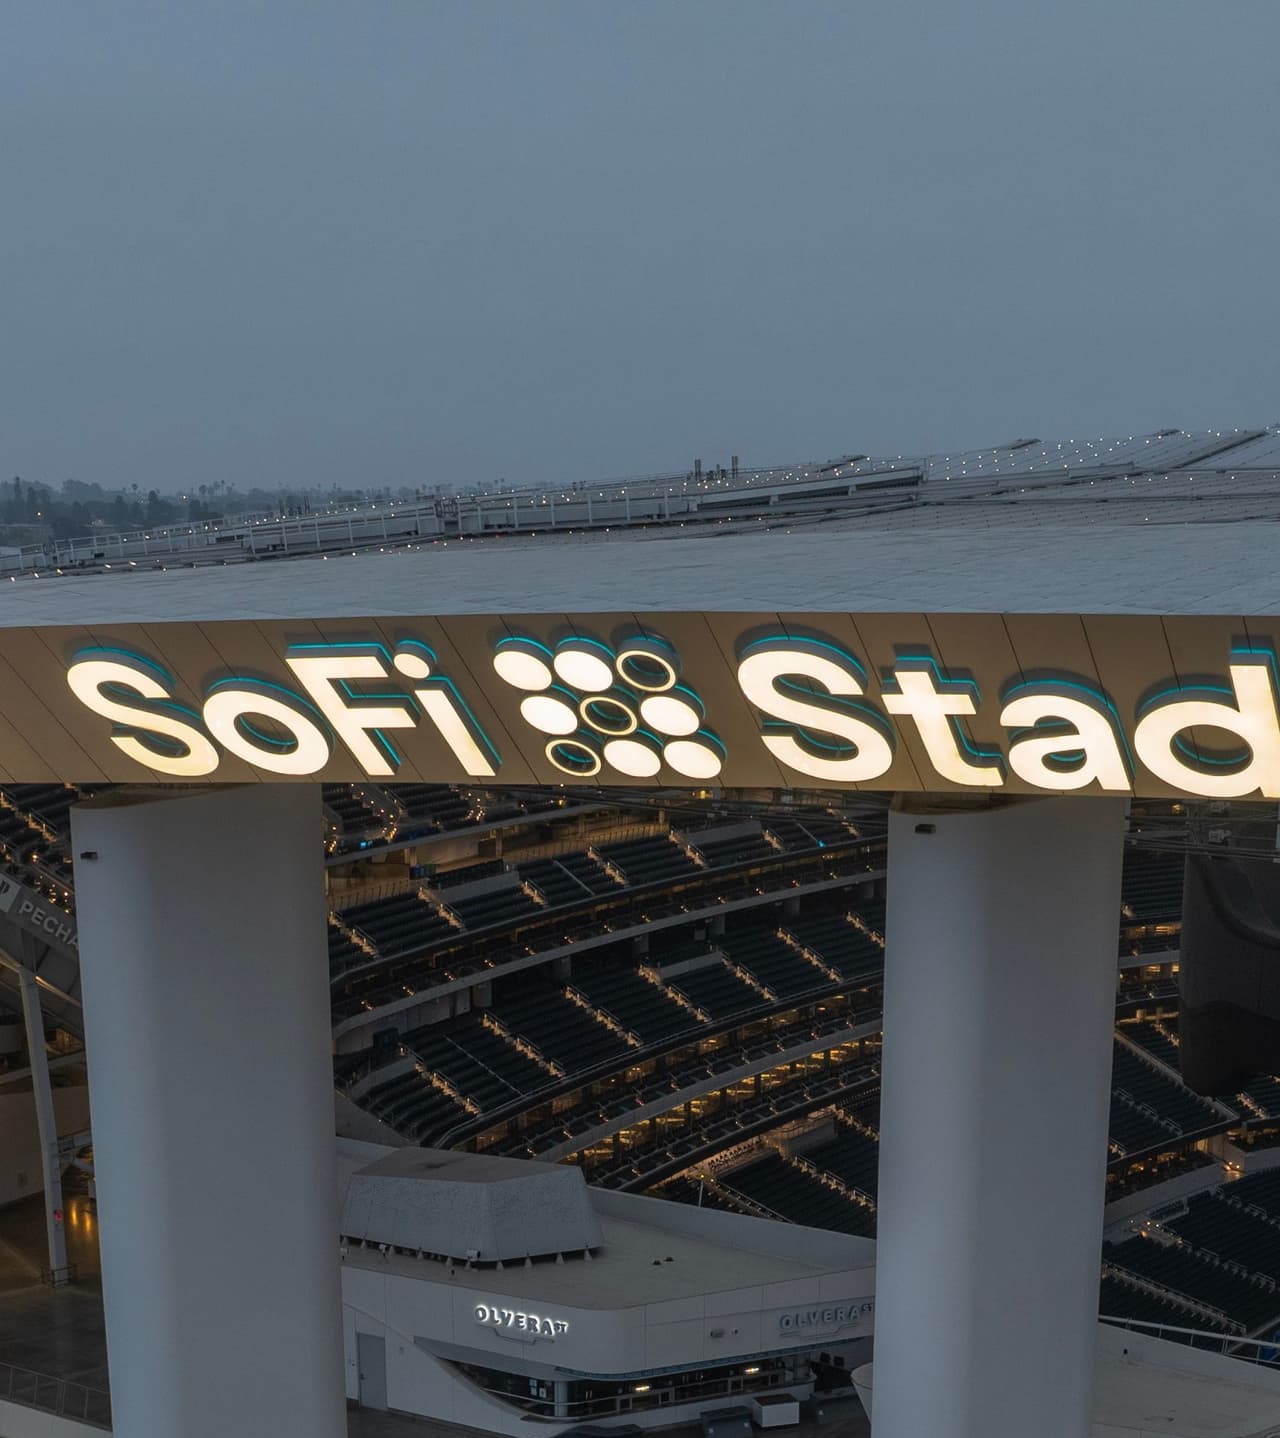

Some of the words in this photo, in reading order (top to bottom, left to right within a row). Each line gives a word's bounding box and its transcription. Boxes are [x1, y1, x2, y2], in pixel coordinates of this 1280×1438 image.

[67, 648, 498, 777] SoFi
[475, 1304, 555, 1336] OLVERA
[780, 1305, 860, 1329] OLVERA
